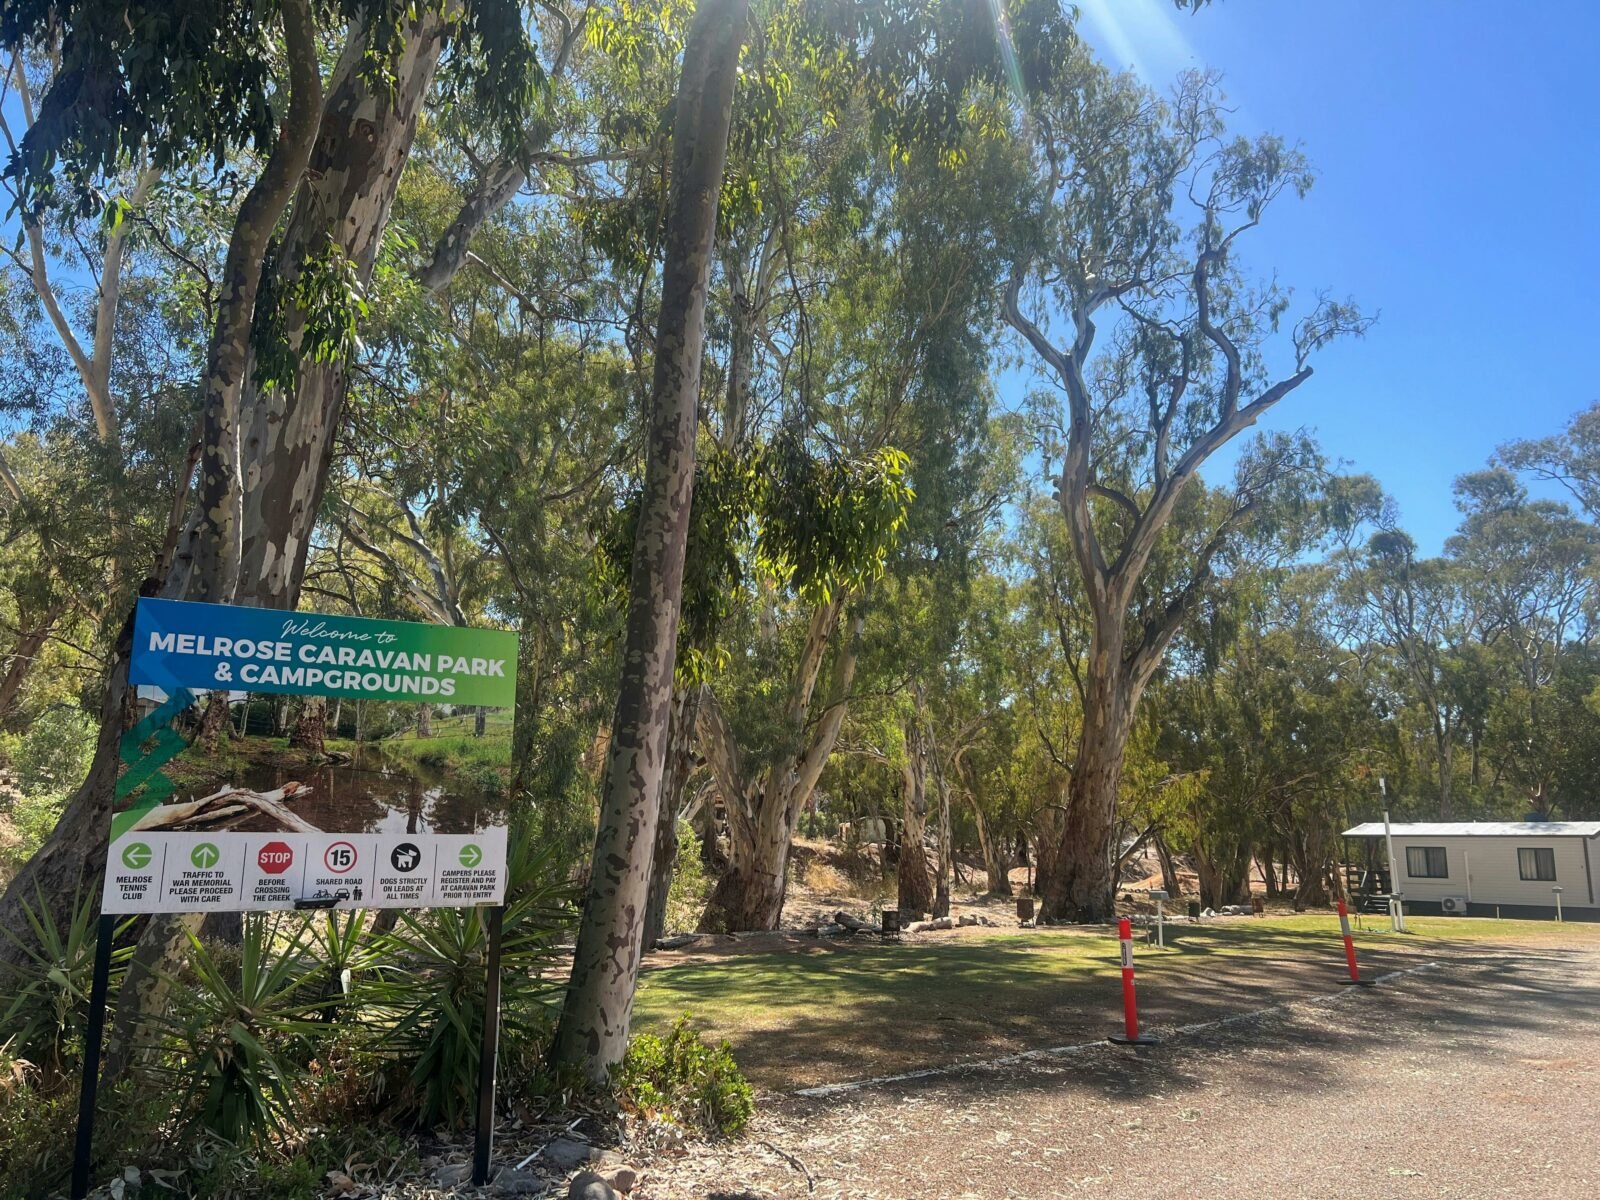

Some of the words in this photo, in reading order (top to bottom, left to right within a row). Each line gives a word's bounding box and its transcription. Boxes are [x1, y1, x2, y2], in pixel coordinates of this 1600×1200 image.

[280, 619, 371, 642] Welcome
[370, 630, 397, 644] to
[149, 631, 292, 661] MELROSE
[299, 644, 430, 671] CARAVAN
[437, 655, 505, 677] PARK
[214, 662, 232, 682] &
[240, 664, 456, 696] CAMPGROUNDS
[260, 853, 290, 864] STOP
[331, 850, 350, 866] 15
[116, 876, 152, 884] MELROSE
[450, 884, 478, 892] CARAVAN
